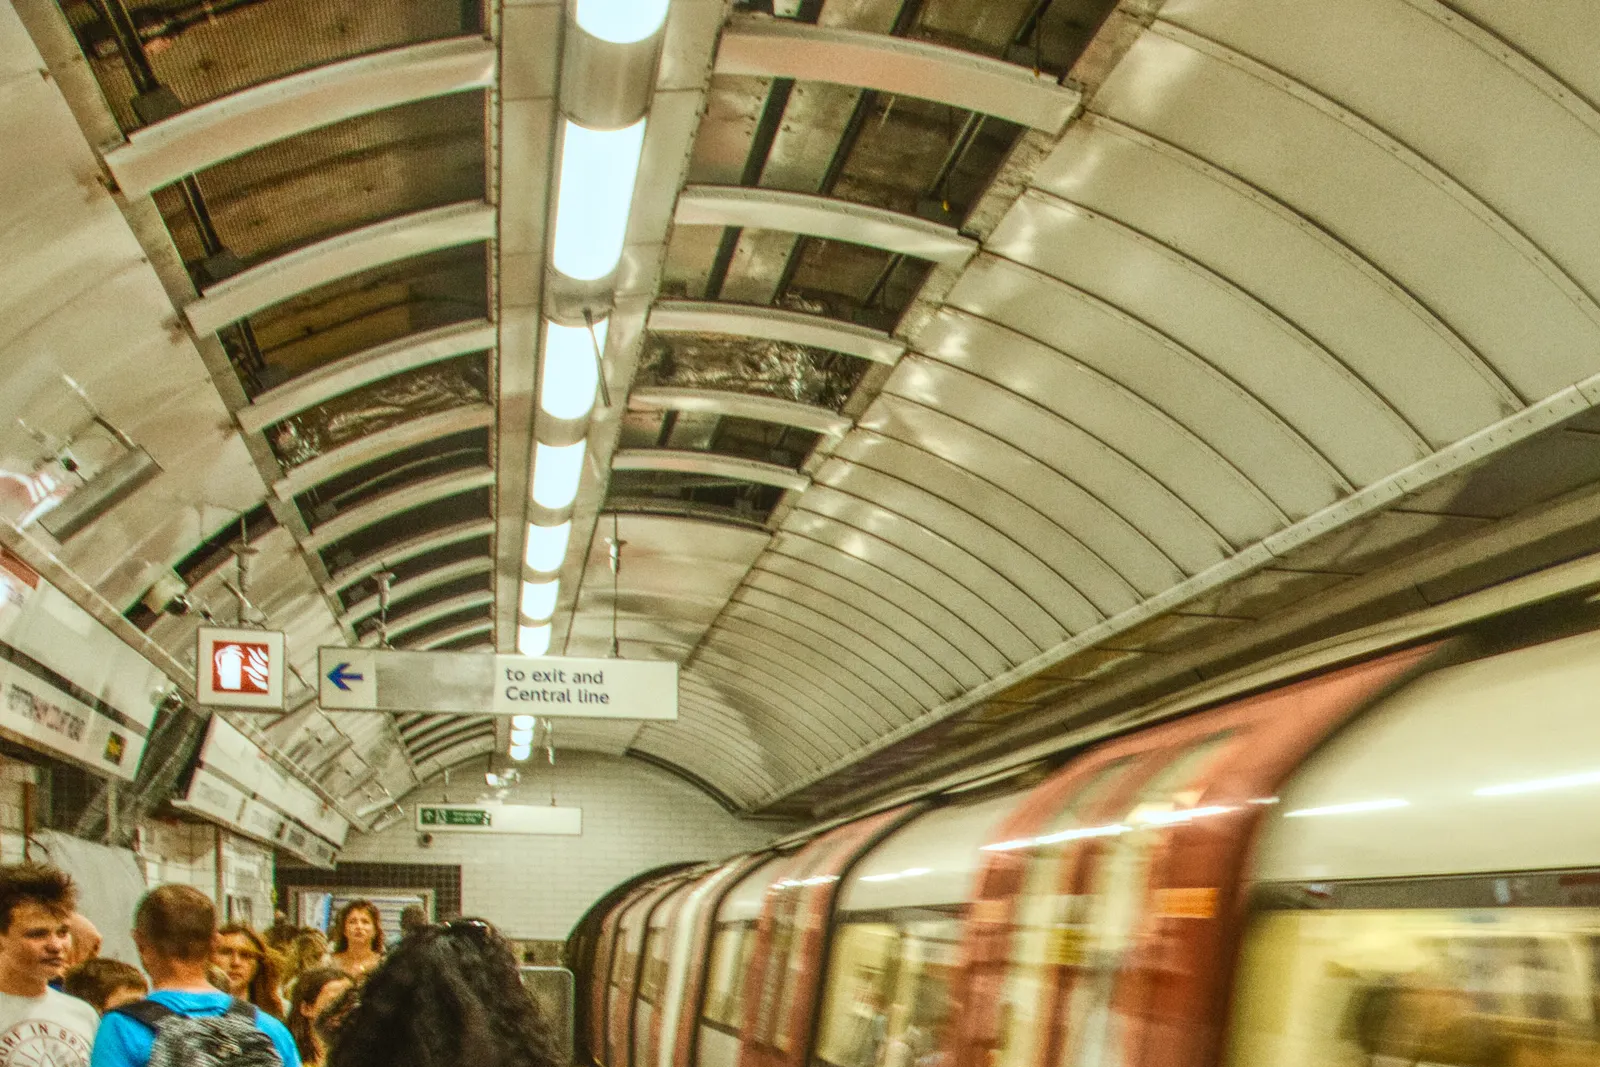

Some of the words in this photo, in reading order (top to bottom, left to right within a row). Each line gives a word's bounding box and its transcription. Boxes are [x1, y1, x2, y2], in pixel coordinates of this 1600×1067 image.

[506, 667, 525, 681] to
[532, 668, 566, 683] exit
[572, 670, 604, 684] and
[506, 686, 571, 703] Central
[578, 688, 609, 704] line
[30, 1023, 49, 1036] IN
